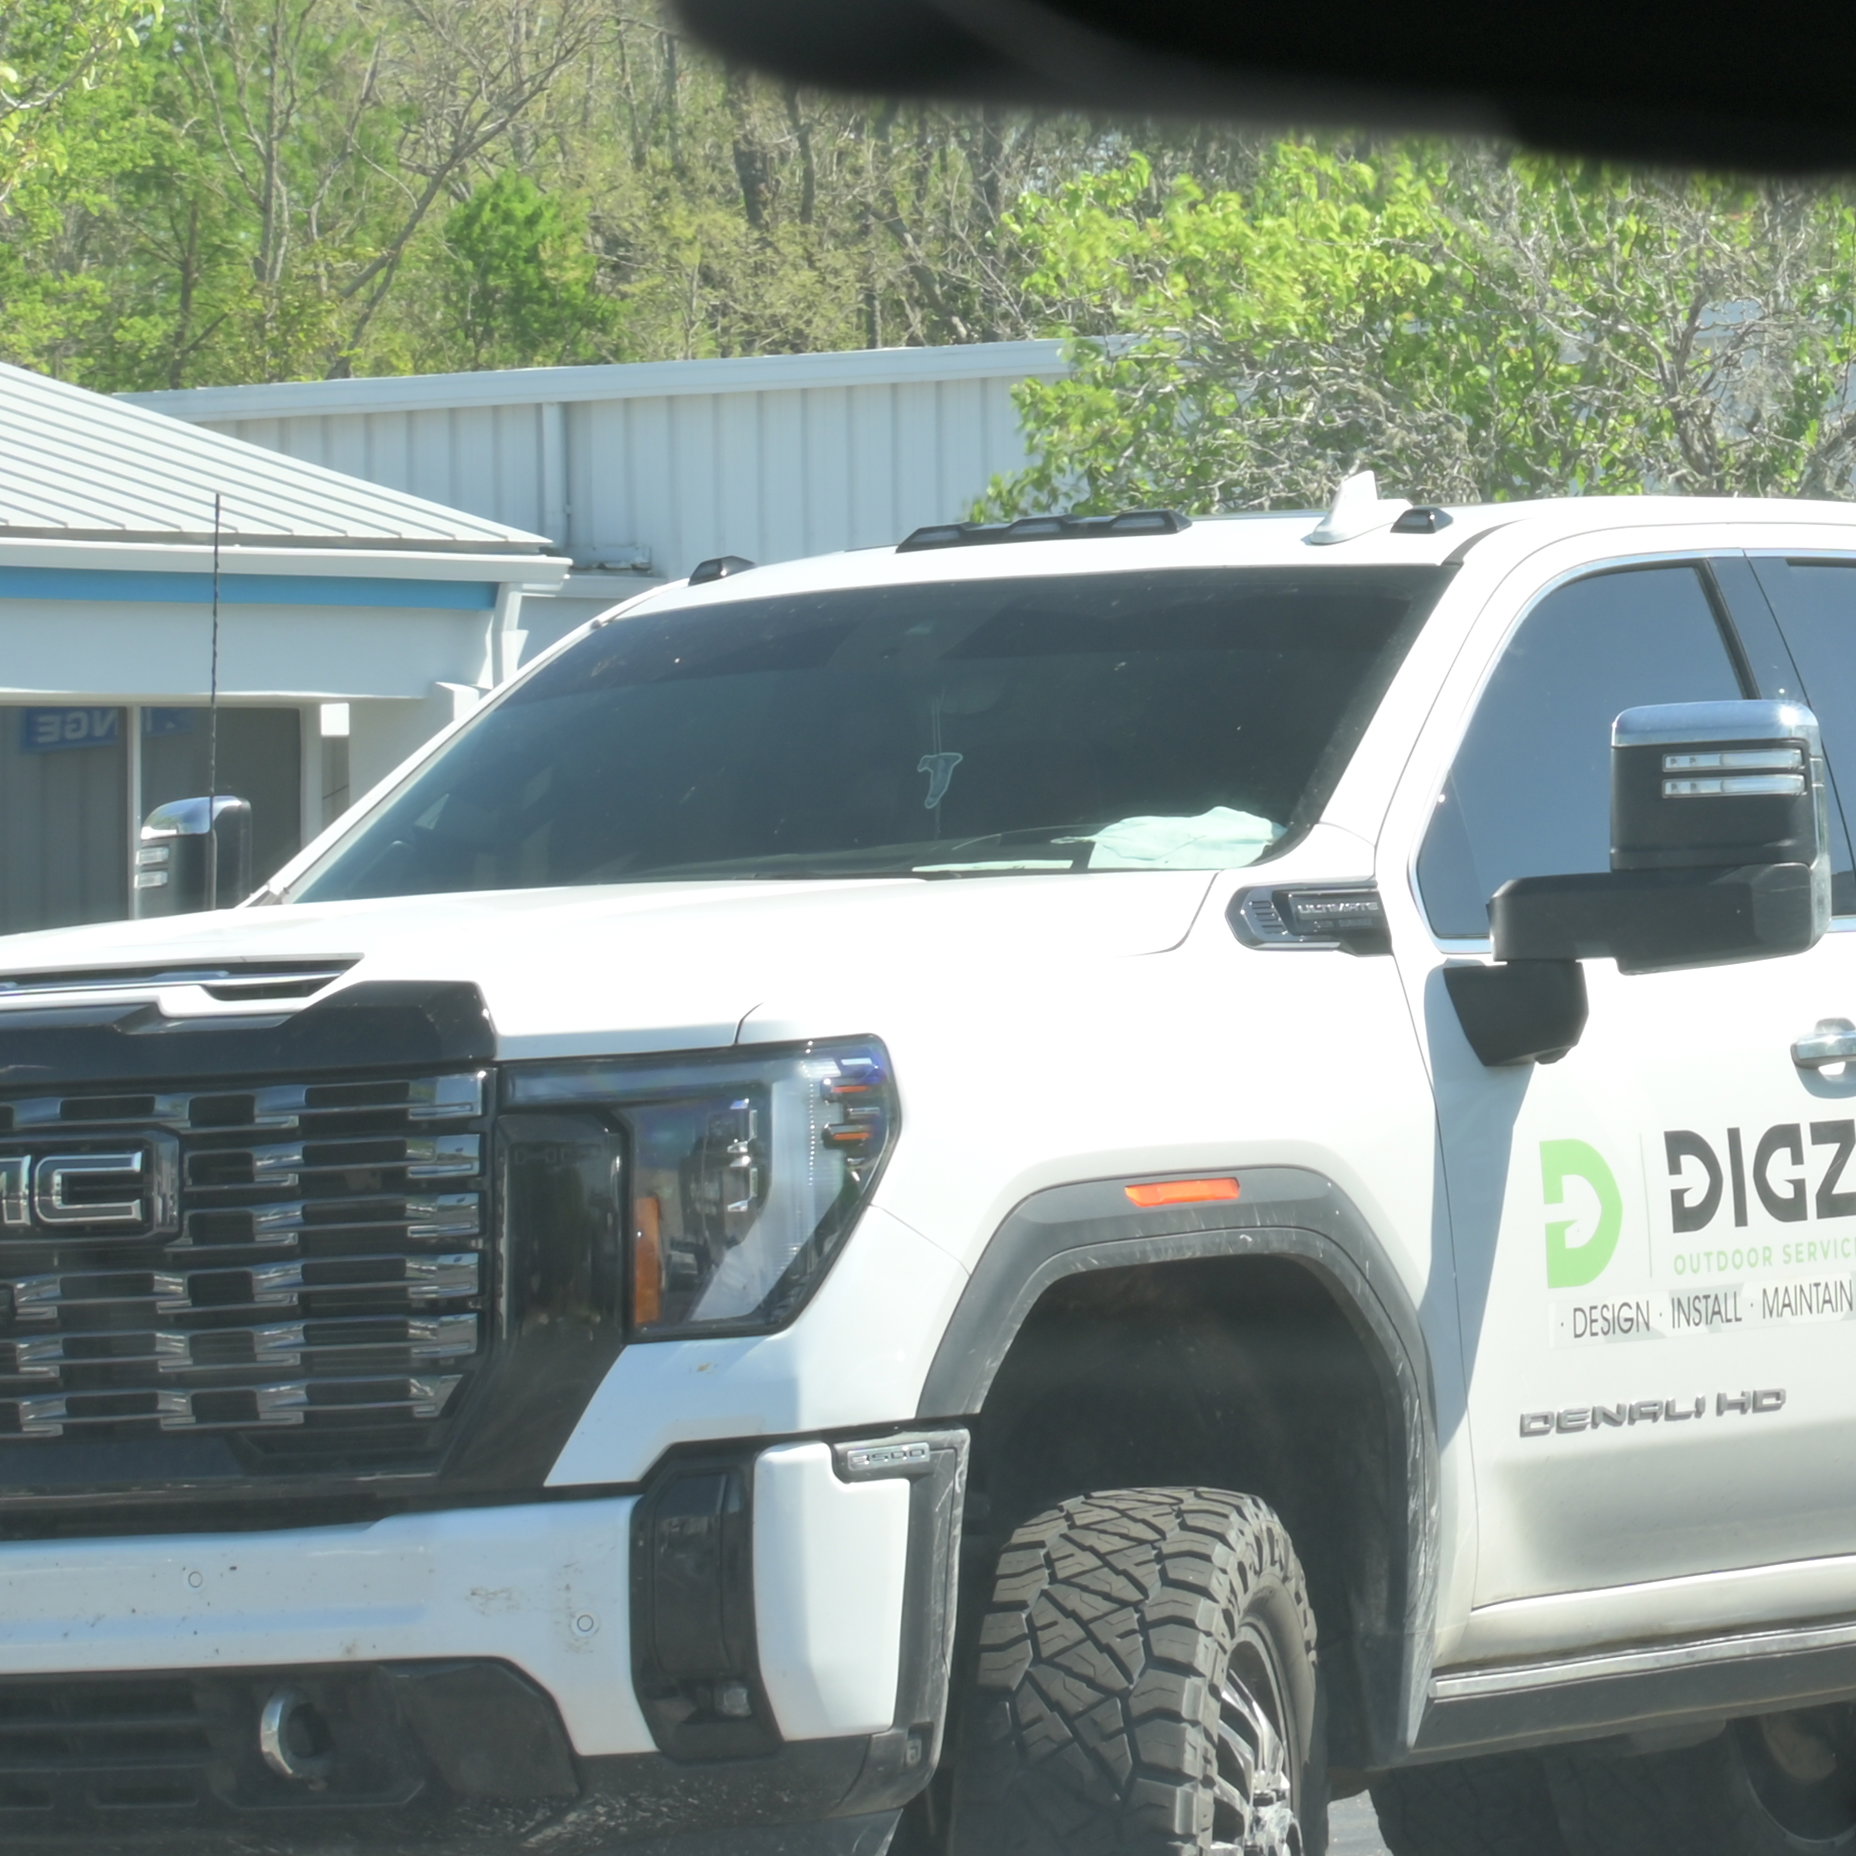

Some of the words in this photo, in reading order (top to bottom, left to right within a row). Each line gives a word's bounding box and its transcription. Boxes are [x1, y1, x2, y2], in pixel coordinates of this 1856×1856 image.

[1673, 1245, 1774, 1276] OUTDOOR
[1572, 1300, 1651, 1339] DESIGN
[1671, 1291, 1743, 1330] INSTALL
[1761, 1279, 1854, 1320] MAINTAIN
[1519, 1394, 1706, 1438] DENALI
[1716, 1388, 1787, 1417] HD
